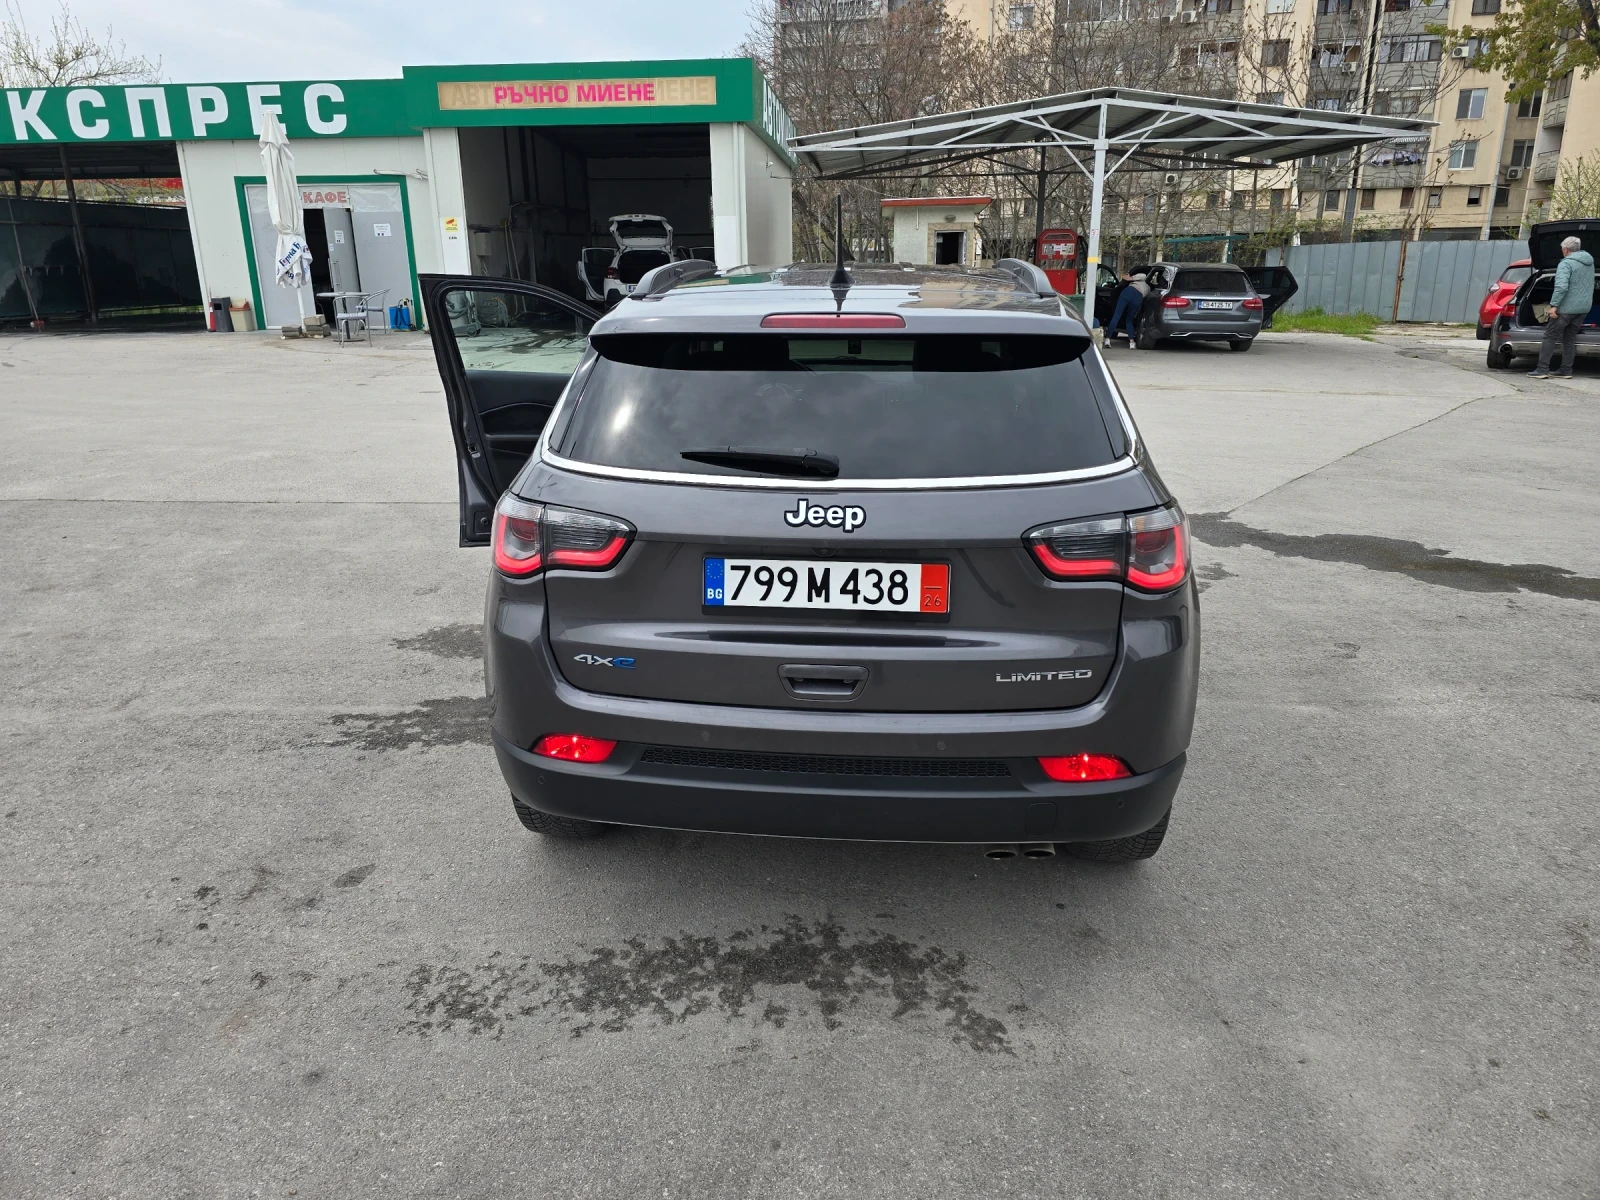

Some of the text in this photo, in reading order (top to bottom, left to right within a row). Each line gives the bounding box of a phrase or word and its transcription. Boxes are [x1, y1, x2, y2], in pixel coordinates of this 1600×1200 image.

[493, 85, 569, 104] РЪЧНО
[576, 83, 655, 103] МИЕНЕ
[303, 191, 347, 203] КАФЕ
[784, 499, 866, 532] Jeep
[707, 565, 909, 605] BG 799 M 438
[924, 594, 942, 607] 26
[995, 669, 1092, 682] LIMITED
